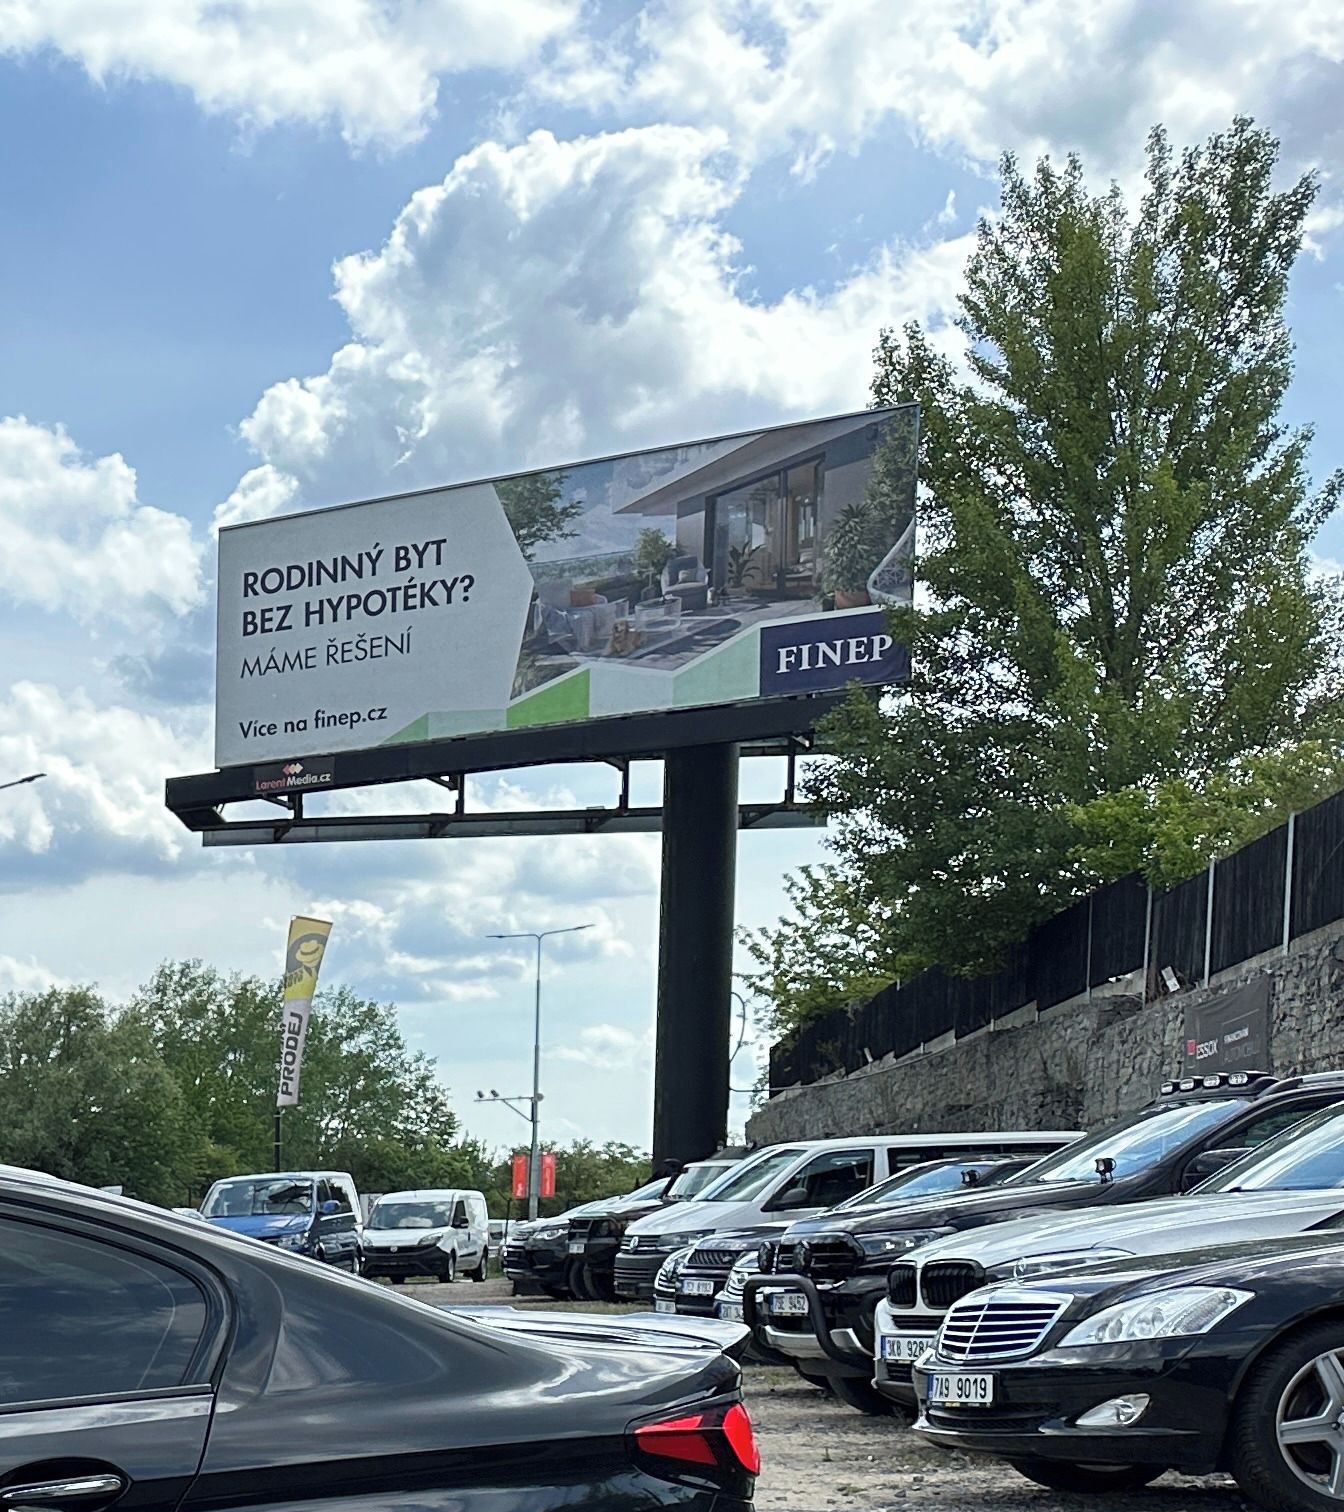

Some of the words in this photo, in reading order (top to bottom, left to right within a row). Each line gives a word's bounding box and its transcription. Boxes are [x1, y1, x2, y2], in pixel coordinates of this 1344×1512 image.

[243, 542, 384, 598] RODINNÝ
[394, 538, 447, 573] BYT
[242, 604, 293, 637] BEZ
[304, 574, 475, 627] HYPOTÉKY?
[240, 646, 317, 679] MÁME
[325, 625, 413, 666] ŘEŠENÍ
[775, 634, 893, 674] FINEP
[239, 718, 278, 739] Více
[283, 718, 308, 733] na
[314, 706, 388, 730] finep.cz
[280, 1011, 304, 1097] PRODEJ
[956, 1377, 987, 1399] 9019
